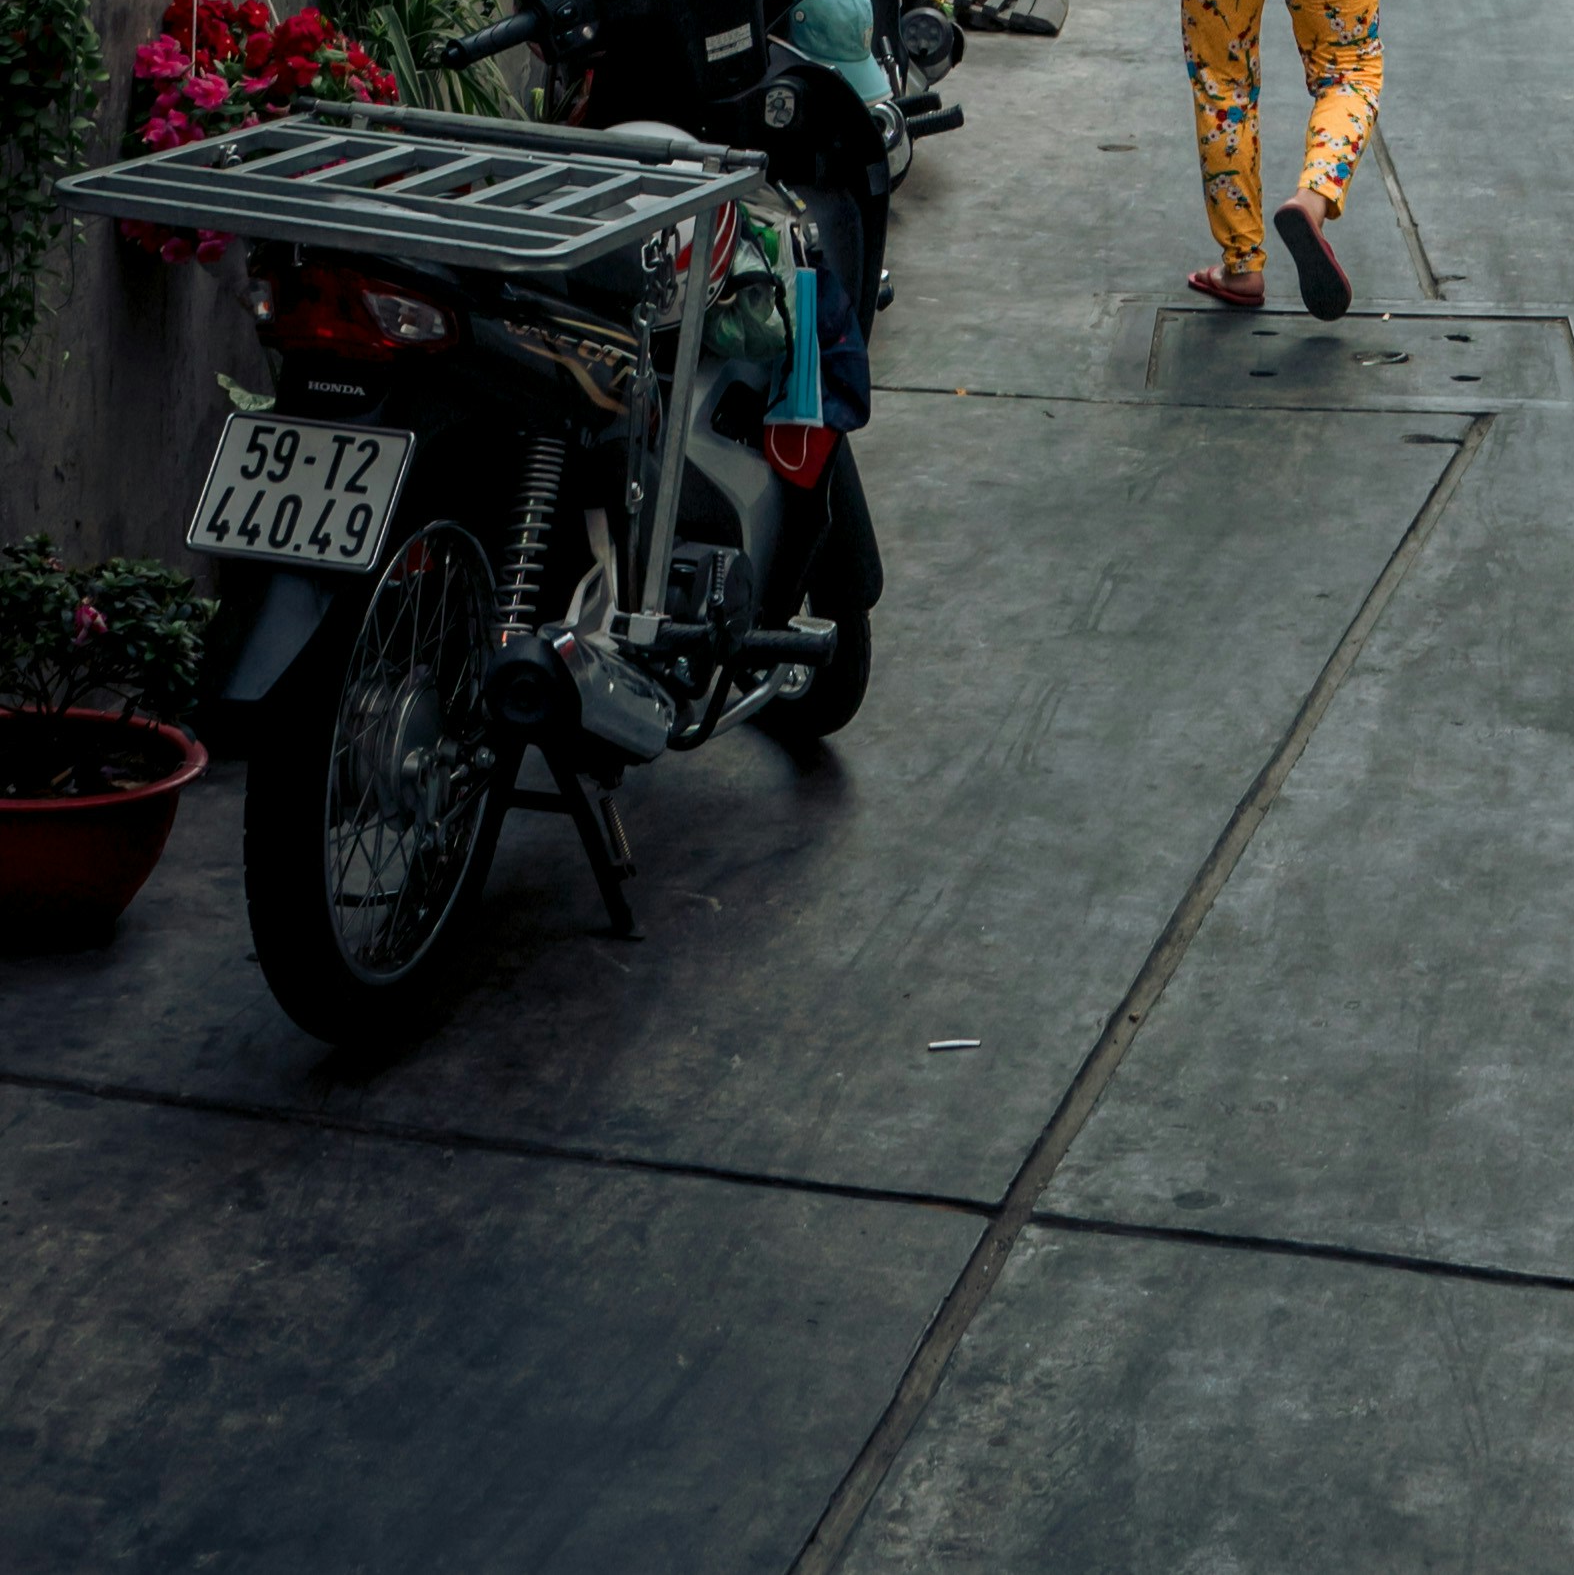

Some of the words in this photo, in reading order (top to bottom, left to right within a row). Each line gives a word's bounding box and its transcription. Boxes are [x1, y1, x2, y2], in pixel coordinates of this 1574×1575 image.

[307, 379, 366, 396] HONDA
[240, 425, 380, 495] 59-T2
[206, 486, 373, 558] 440.49
